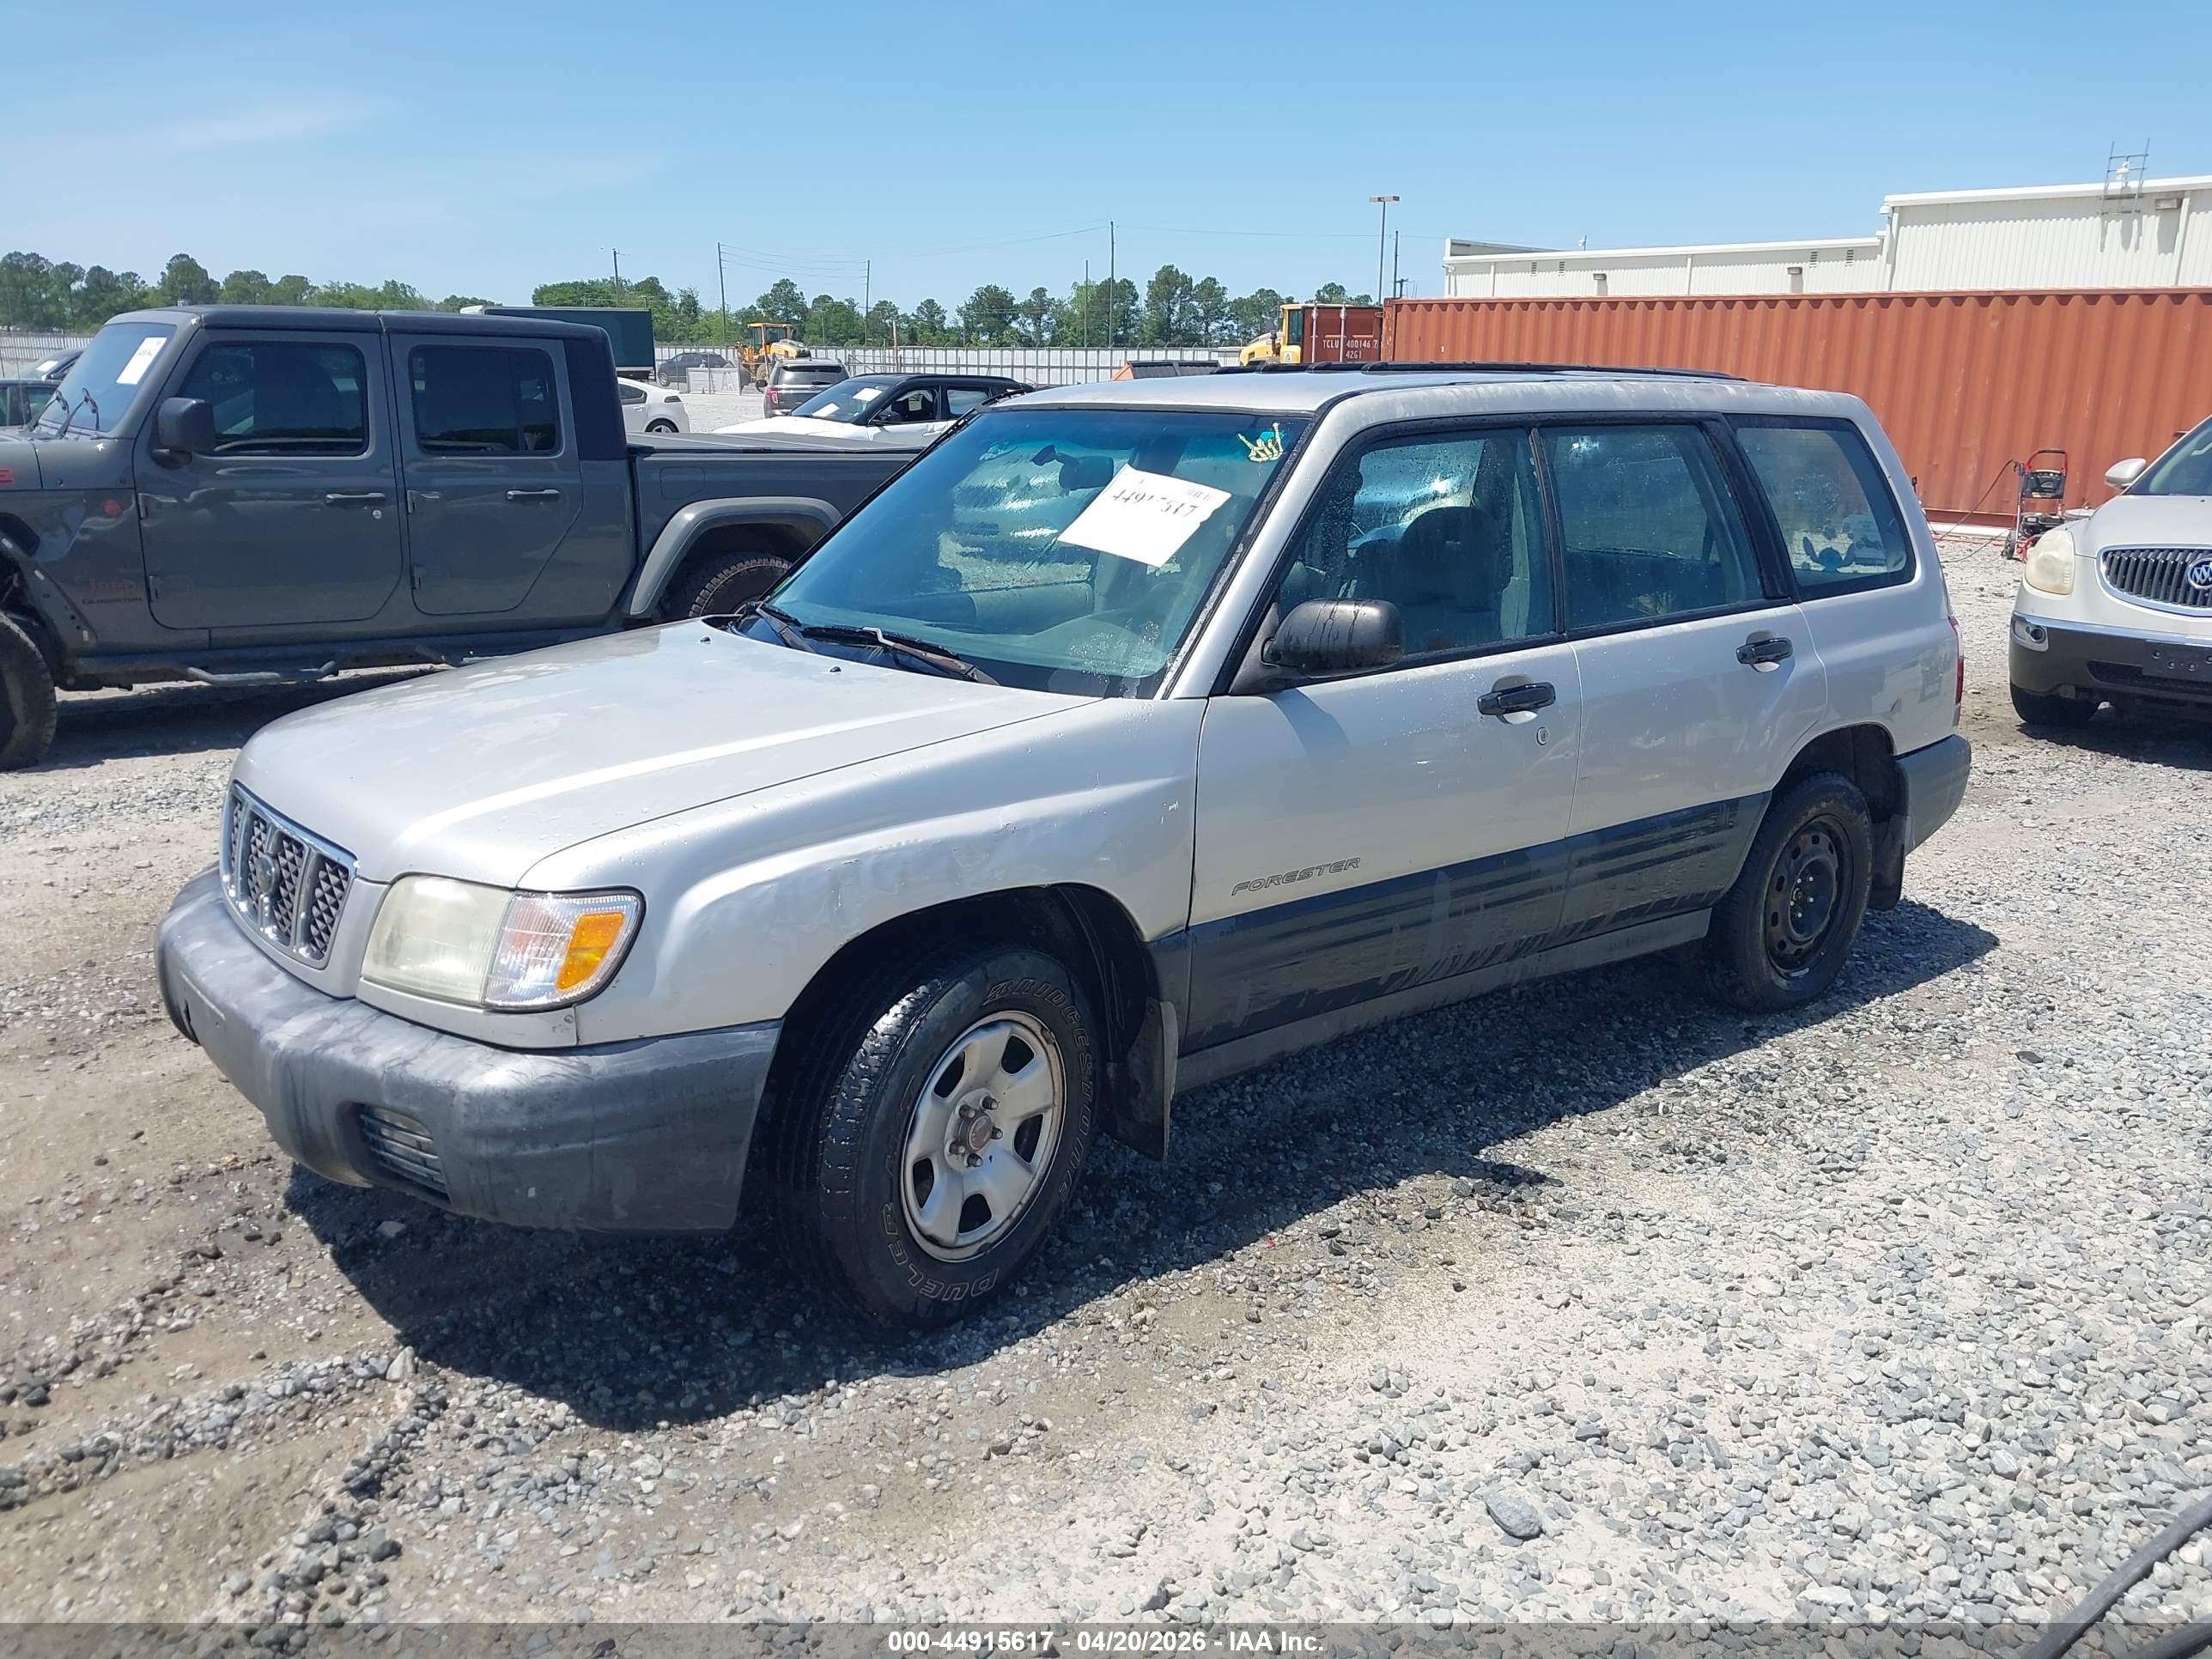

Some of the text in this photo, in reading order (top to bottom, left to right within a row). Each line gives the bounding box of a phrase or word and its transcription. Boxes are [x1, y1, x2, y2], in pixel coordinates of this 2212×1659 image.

[1322, 339, 1339, 349] TCLU
[1346, 339, 1370, 349] 400146
[1345, 350, 1362, 359] 42G1
[1231, 857, 1361, 896] FORESTER
[879, 1200, 1000, 1303] DUELER
